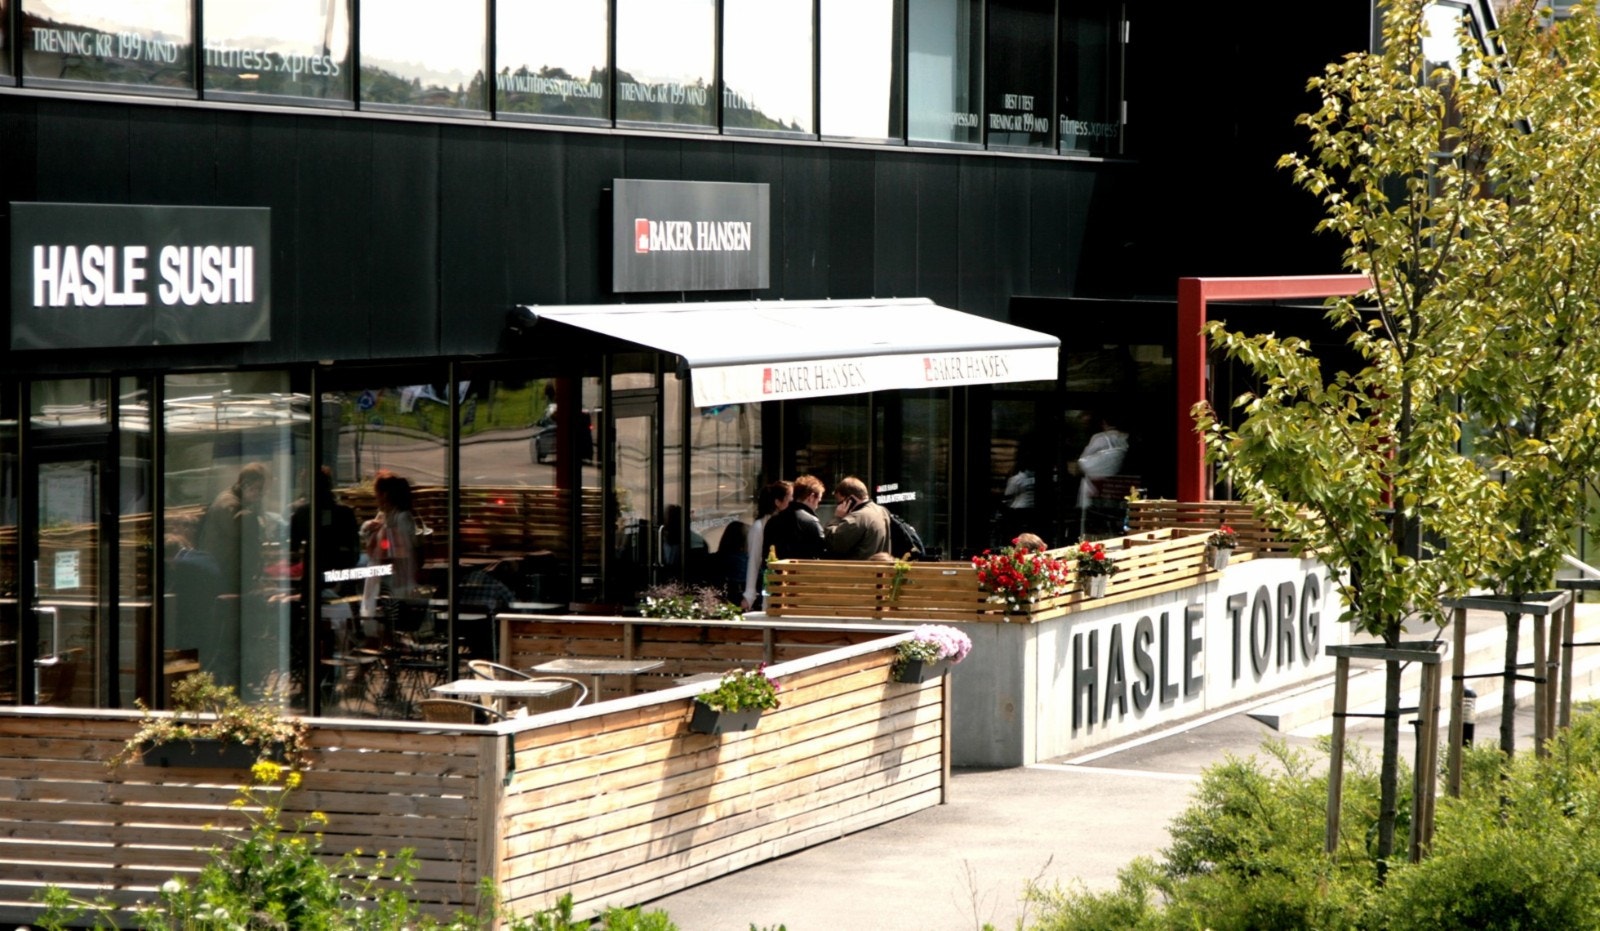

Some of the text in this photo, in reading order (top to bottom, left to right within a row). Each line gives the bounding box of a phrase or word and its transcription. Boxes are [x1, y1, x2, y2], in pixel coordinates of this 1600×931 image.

[32, 27, 177, 63] TRENING KR 199 MND
[620, 82, 656, 103] TRENING
[657, 86, 668, 104] KR
[670, 82, 686, 105] 199
[1004, 93, 1018, 110] BEST
[1021, 95, 1034, 111] TEST
[989, 113, 1014, 131] TRENING
[1023, 112, 1034, 132] 199
[648, 220, 752, 251] BAKER HANSEN
[33, 245, 254, 307] HASLE SUSHI
[774, 362, 867, 393] BAKER HANSEN
[932, 355, 1009, 381] BAKER HANSEN
[1073, 573, 1321, 731] HASLE TORG
